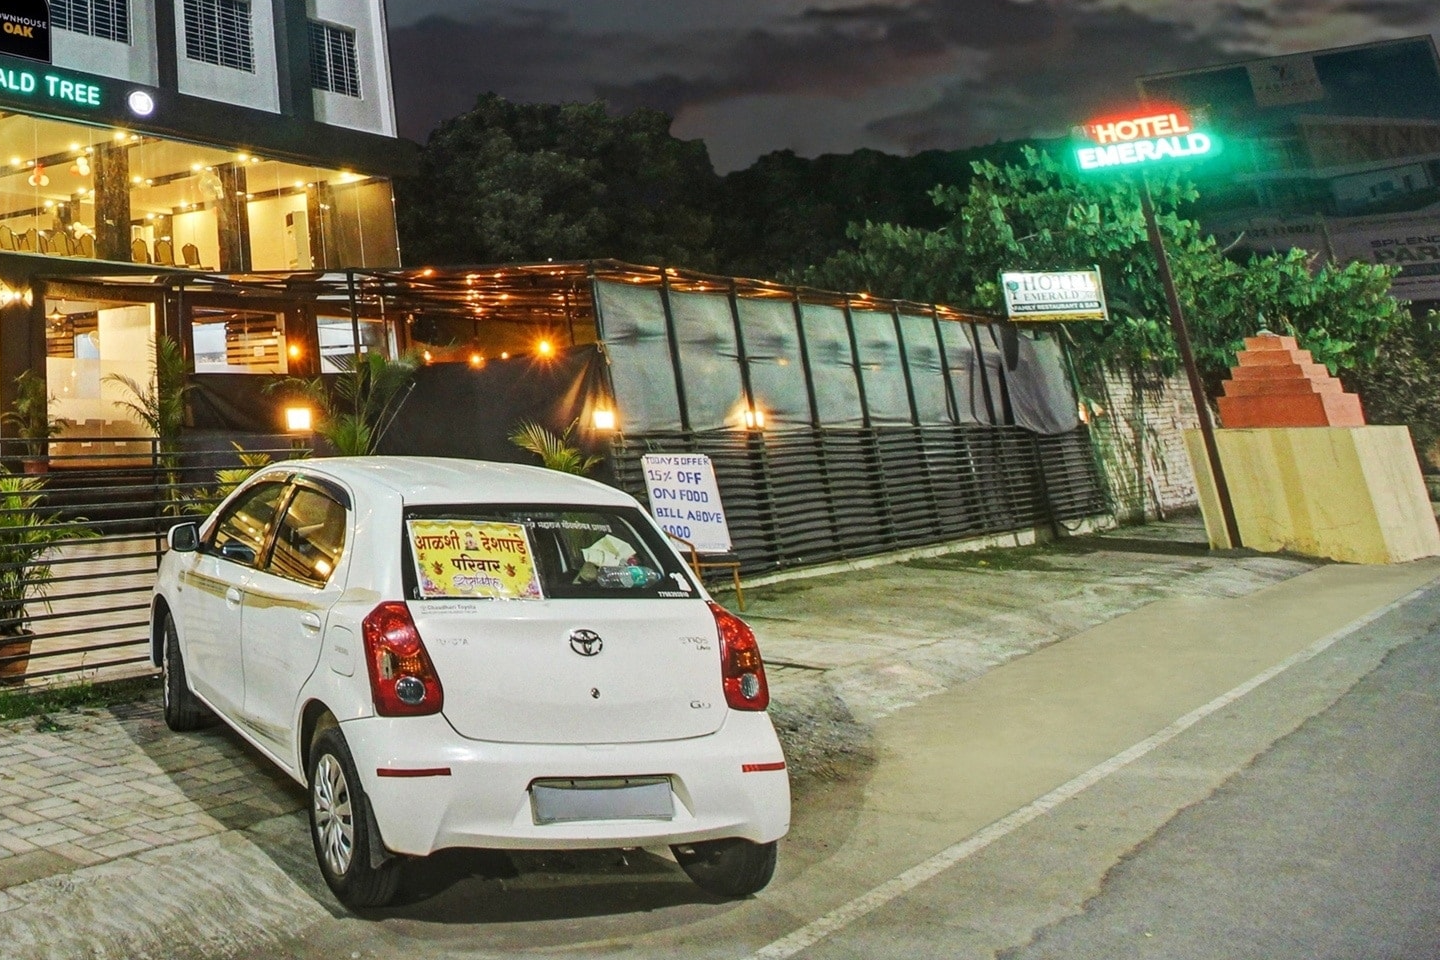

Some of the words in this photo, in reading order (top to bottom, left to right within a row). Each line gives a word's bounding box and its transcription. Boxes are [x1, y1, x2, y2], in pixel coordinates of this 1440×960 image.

[3, 21, 34, 38] OAK
[45, 75, 101, 106] TREE
[1095, 113, 1190, 144] HOTEL
[1077, 132, 1211, 170] EMERALD
[1024, 290, 1080, 301] EMERALD
[681, 457, 709, 465] OFFER
[648, 469, 672, 482] 15%
[677, 471, 702, 484] OFF
[653, 488, 676, 499] ON
[679, 489, 709, 503] FOOD
[656, 507, 684, 519] BILL
[687, 510, 722, 523] ABOVE
[415, 529, 461, 551] आळशी
[479, 531, 527, 555] देशपांडे
[451, 553, 501, 573] परिवार
